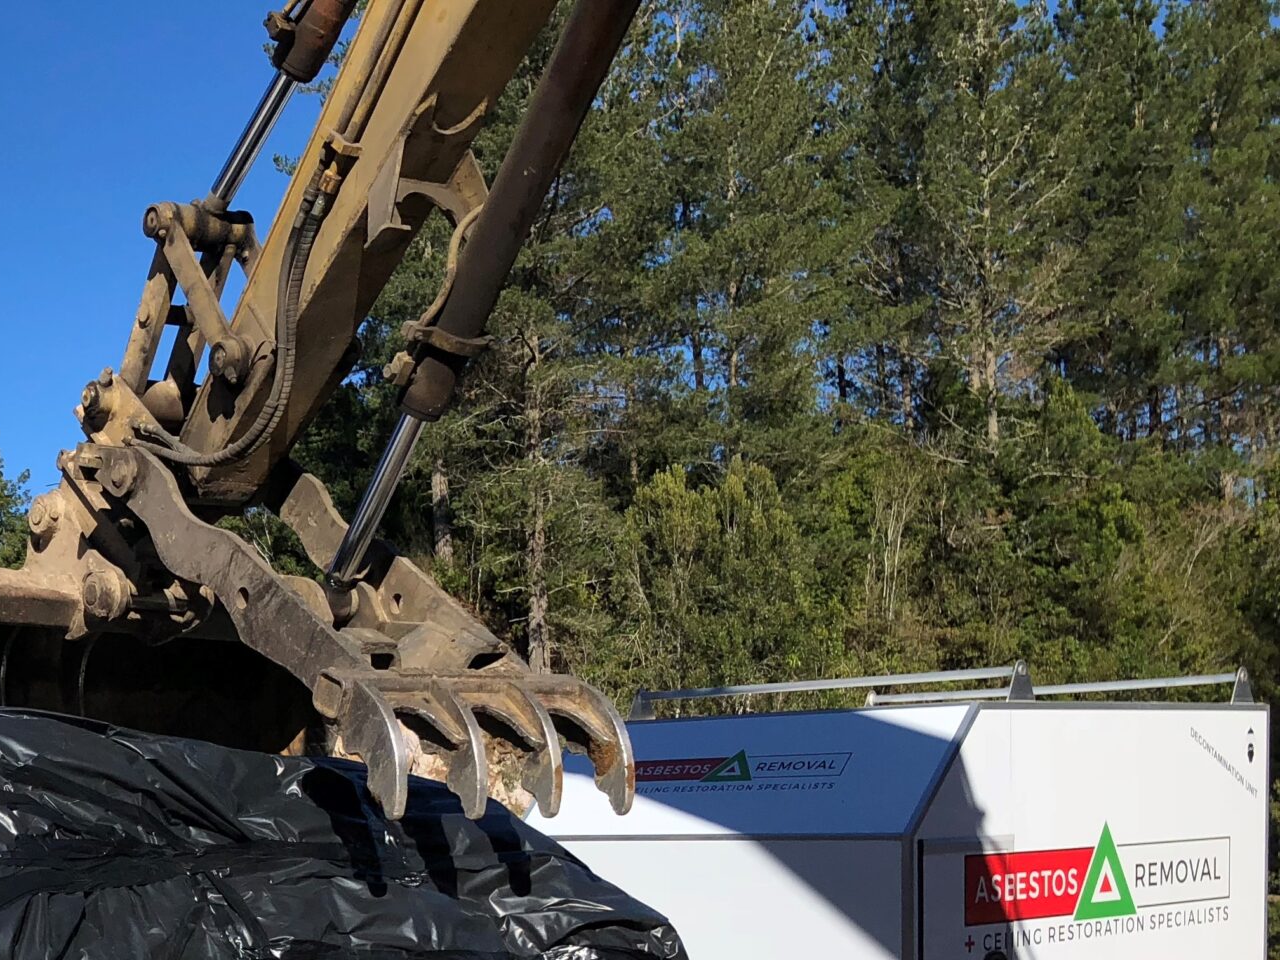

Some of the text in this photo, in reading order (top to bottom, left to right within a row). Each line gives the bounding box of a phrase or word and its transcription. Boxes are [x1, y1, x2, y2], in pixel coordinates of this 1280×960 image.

[635, 758, 836, 776] ASBESTOS REMOVAL
[1190, 726, 1258, 799] DECONTAMINATION UNIT
[673, 783, 754, 793] RESTORATION
[756, 781, 836, 792] SPECIALISTS
[975, 856, 1222, 904] ASBESTOS REMOVAL
[1048, 916, 1145, 944] RESTORATION
[1149, 905, 1230, 931] SPECIALISTS
